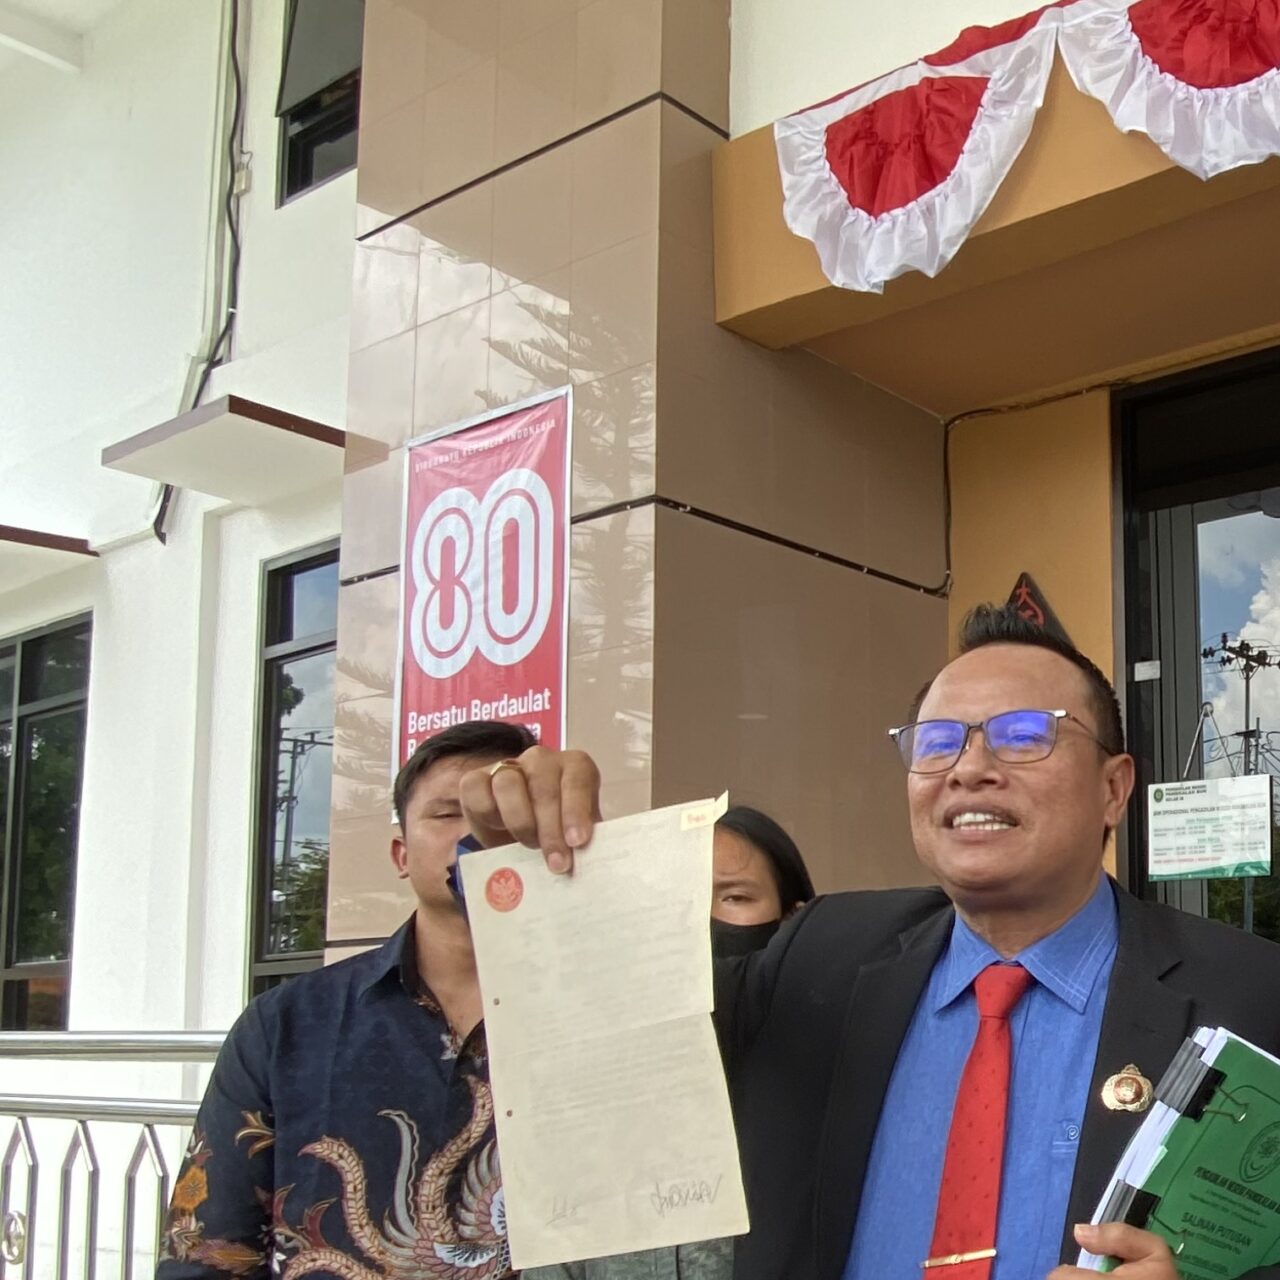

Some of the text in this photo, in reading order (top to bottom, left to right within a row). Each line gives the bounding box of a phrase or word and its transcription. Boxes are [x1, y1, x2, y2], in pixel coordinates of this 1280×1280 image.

[410, 468, 553, 679] 80
[407, 689, 550, 735] Bersatu Berdaulat
